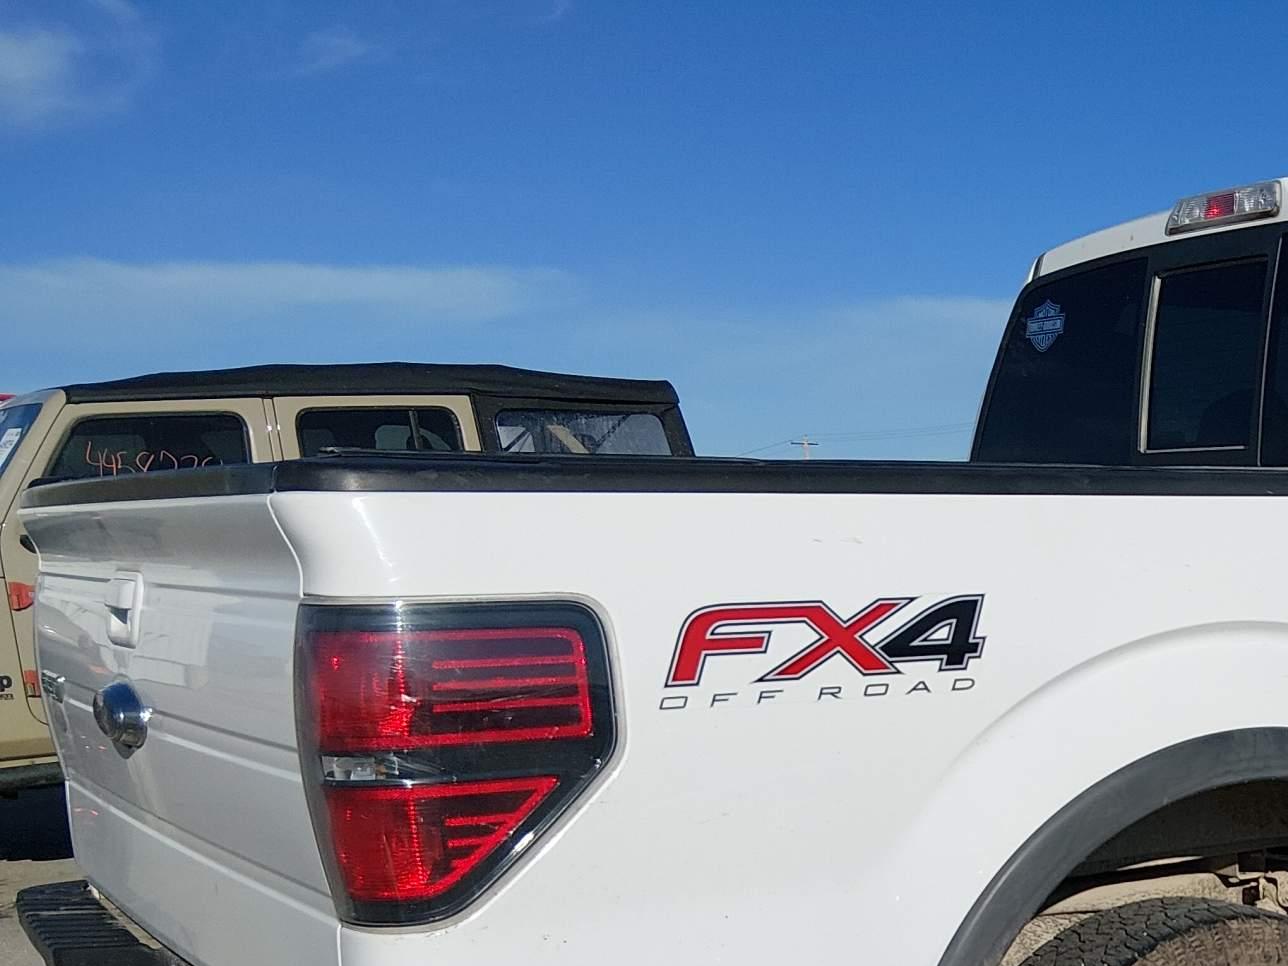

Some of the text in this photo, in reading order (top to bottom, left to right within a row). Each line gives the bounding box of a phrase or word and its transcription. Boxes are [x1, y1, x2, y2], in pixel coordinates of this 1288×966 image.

[664, 594, 987, 689] FX4
[659, 678, 976, 710] OFF ROAD
